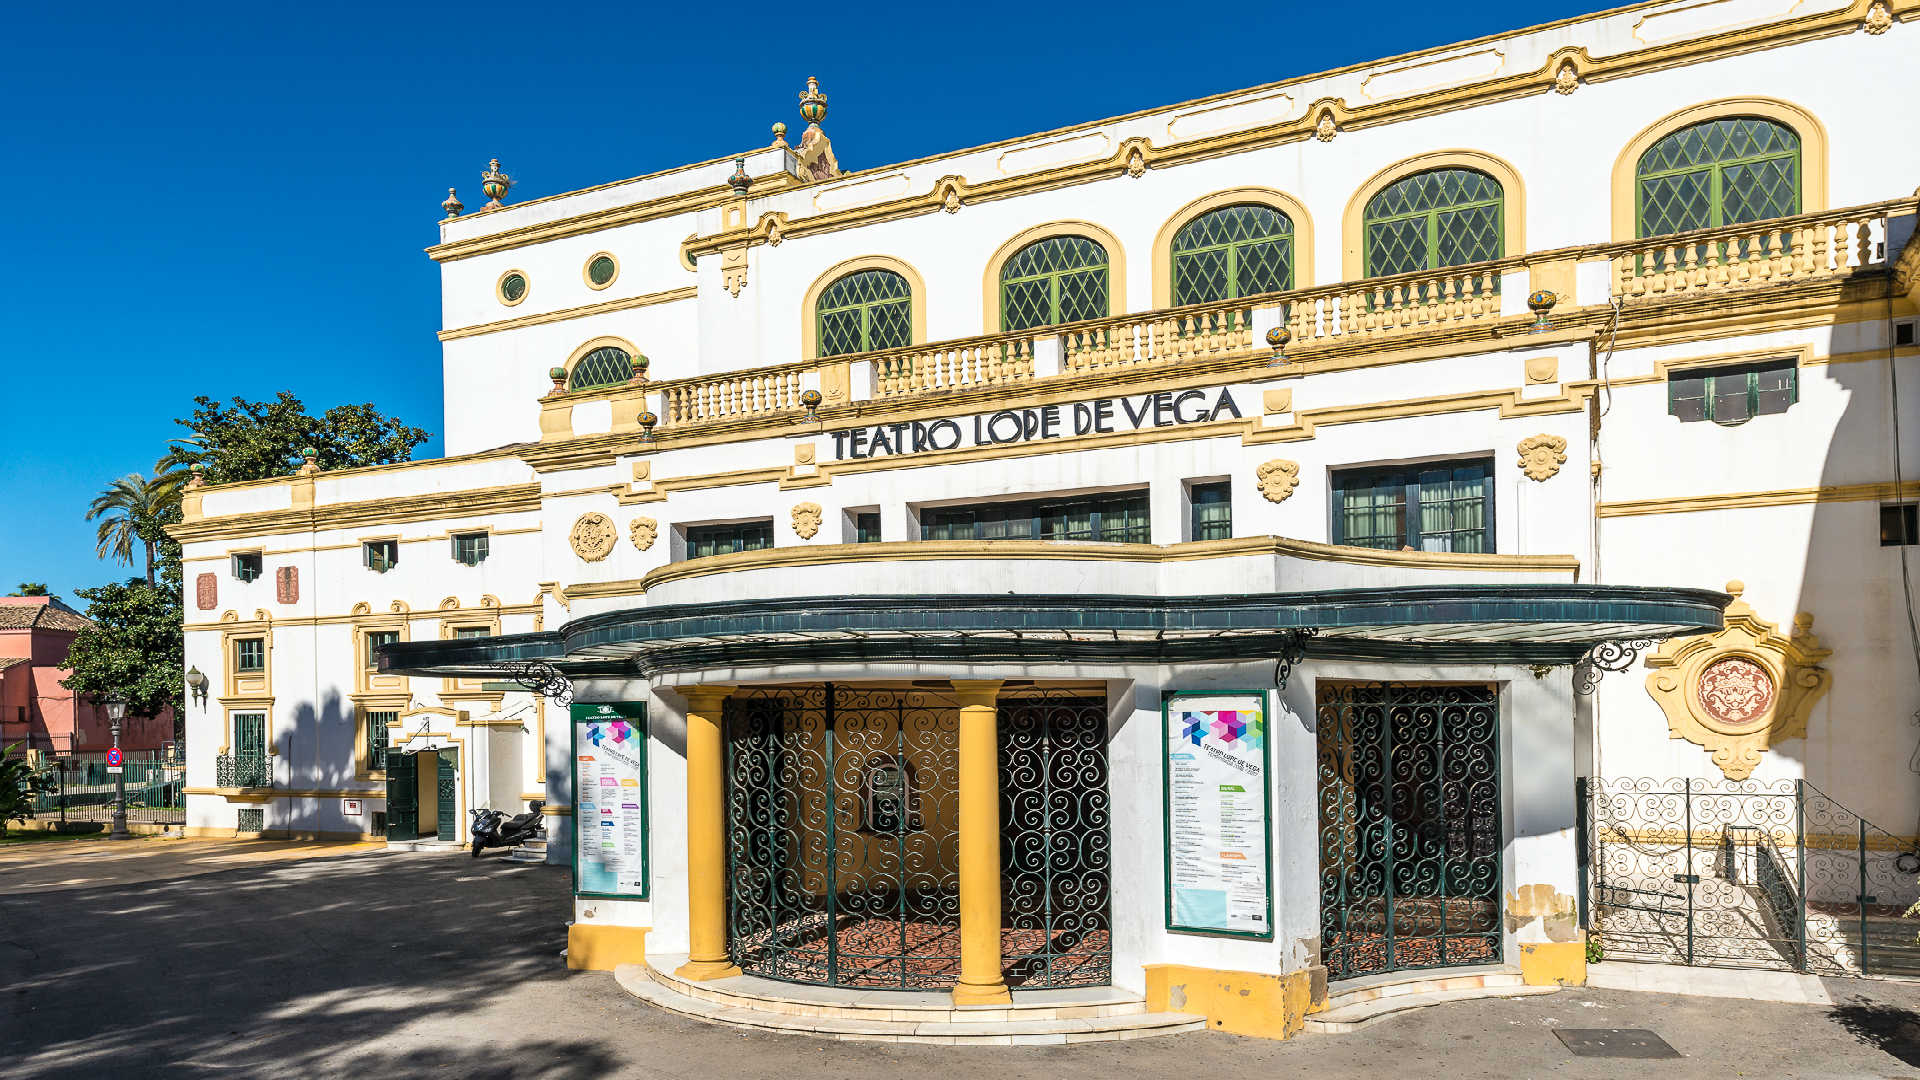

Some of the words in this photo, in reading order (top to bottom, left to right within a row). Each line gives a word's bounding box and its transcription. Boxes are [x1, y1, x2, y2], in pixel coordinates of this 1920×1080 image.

[831, 419, 961, 460] TEATRO
[975, 405, 1060, 446] LOPE
[1073, 400, 1114, 436] DE
[1121, 386, 1242, 429] VEGA
